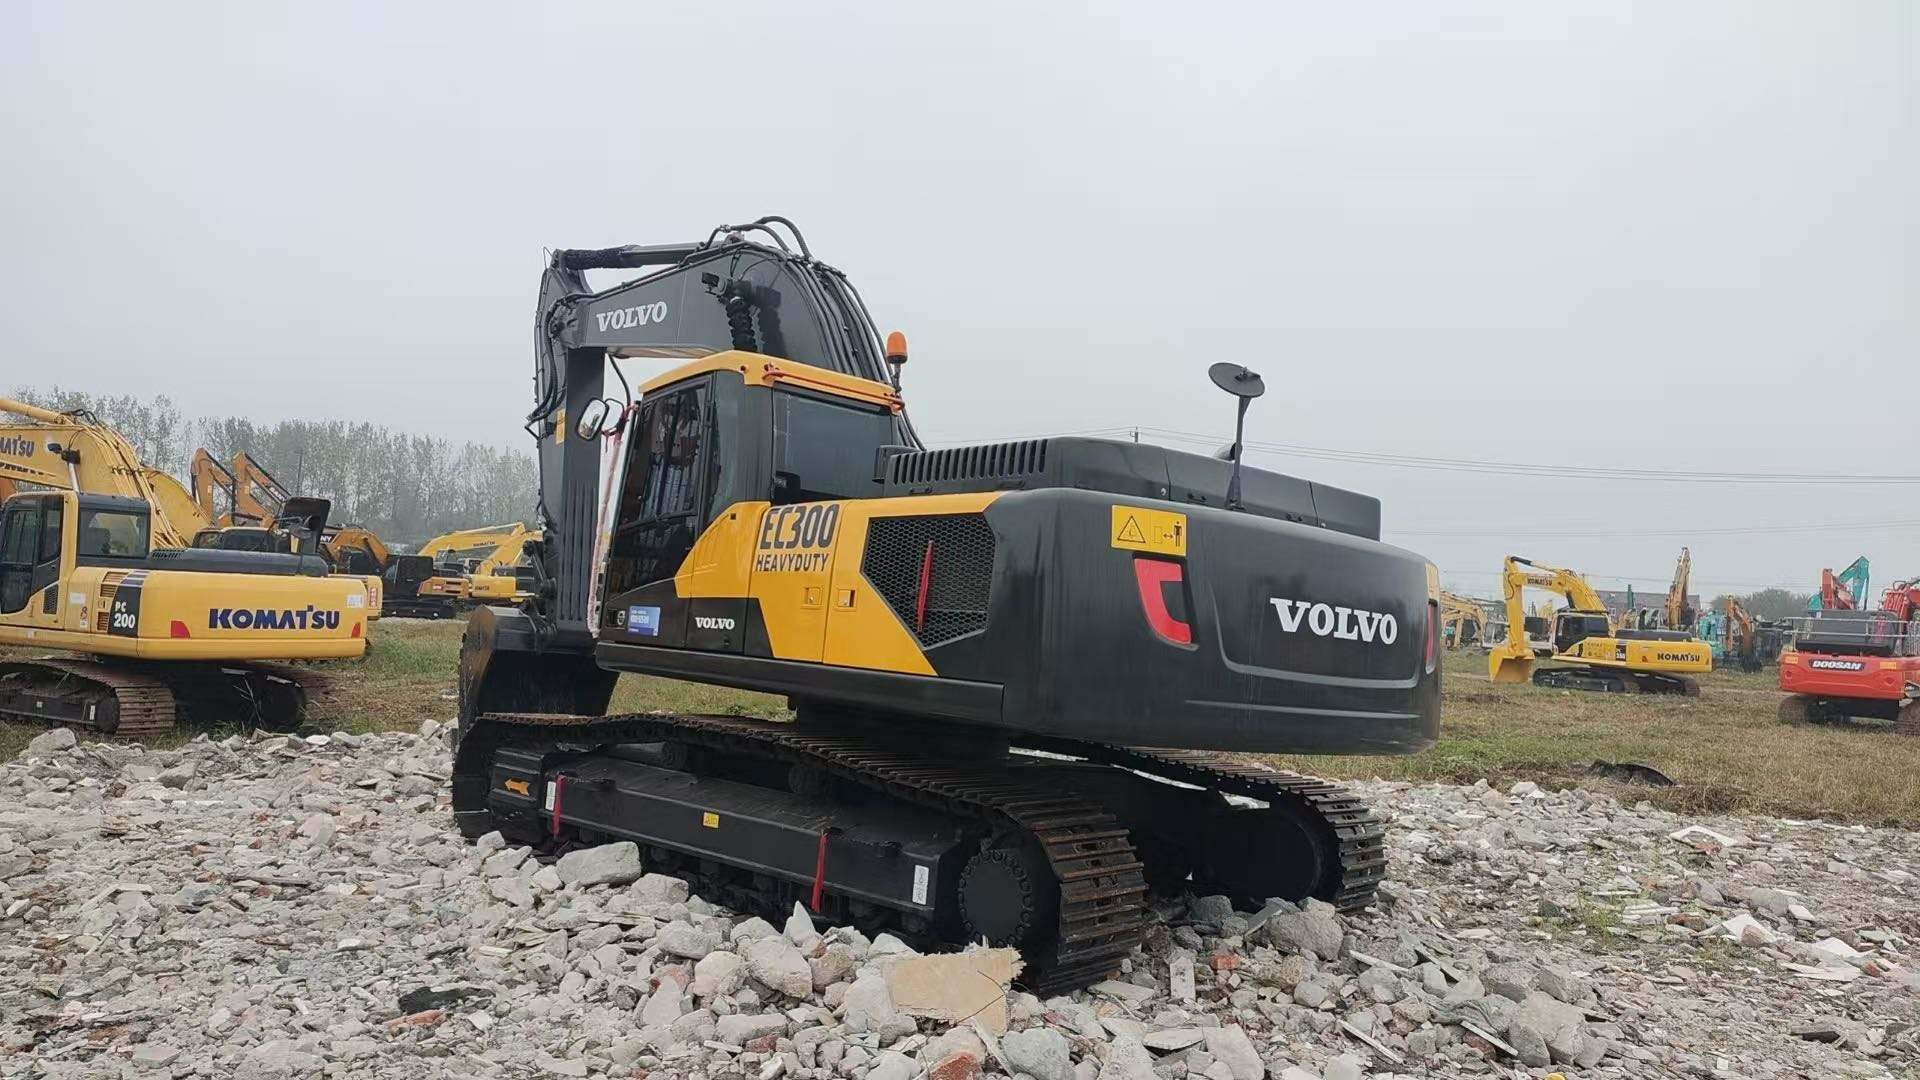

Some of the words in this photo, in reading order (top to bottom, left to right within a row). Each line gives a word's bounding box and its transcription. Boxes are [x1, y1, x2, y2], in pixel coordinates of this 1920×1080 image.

[596, 301, 667, 332] VOLVO
[760, 504, 840, 550] EC300
[755, 553, 829, 572] HEAVYDUTY
[115, 601, 127, 612] PC
[113, 613, 137, 629] 200
[208, 605, 340, 630] KOMATSU
[695, 617, 735, 630] VOLVO
[1270, 597, 1398, 645] VOLVO
[1657, 651, 1700, 662] KOMATSU
[1812, 660, 1862, 670] DOOSAN
